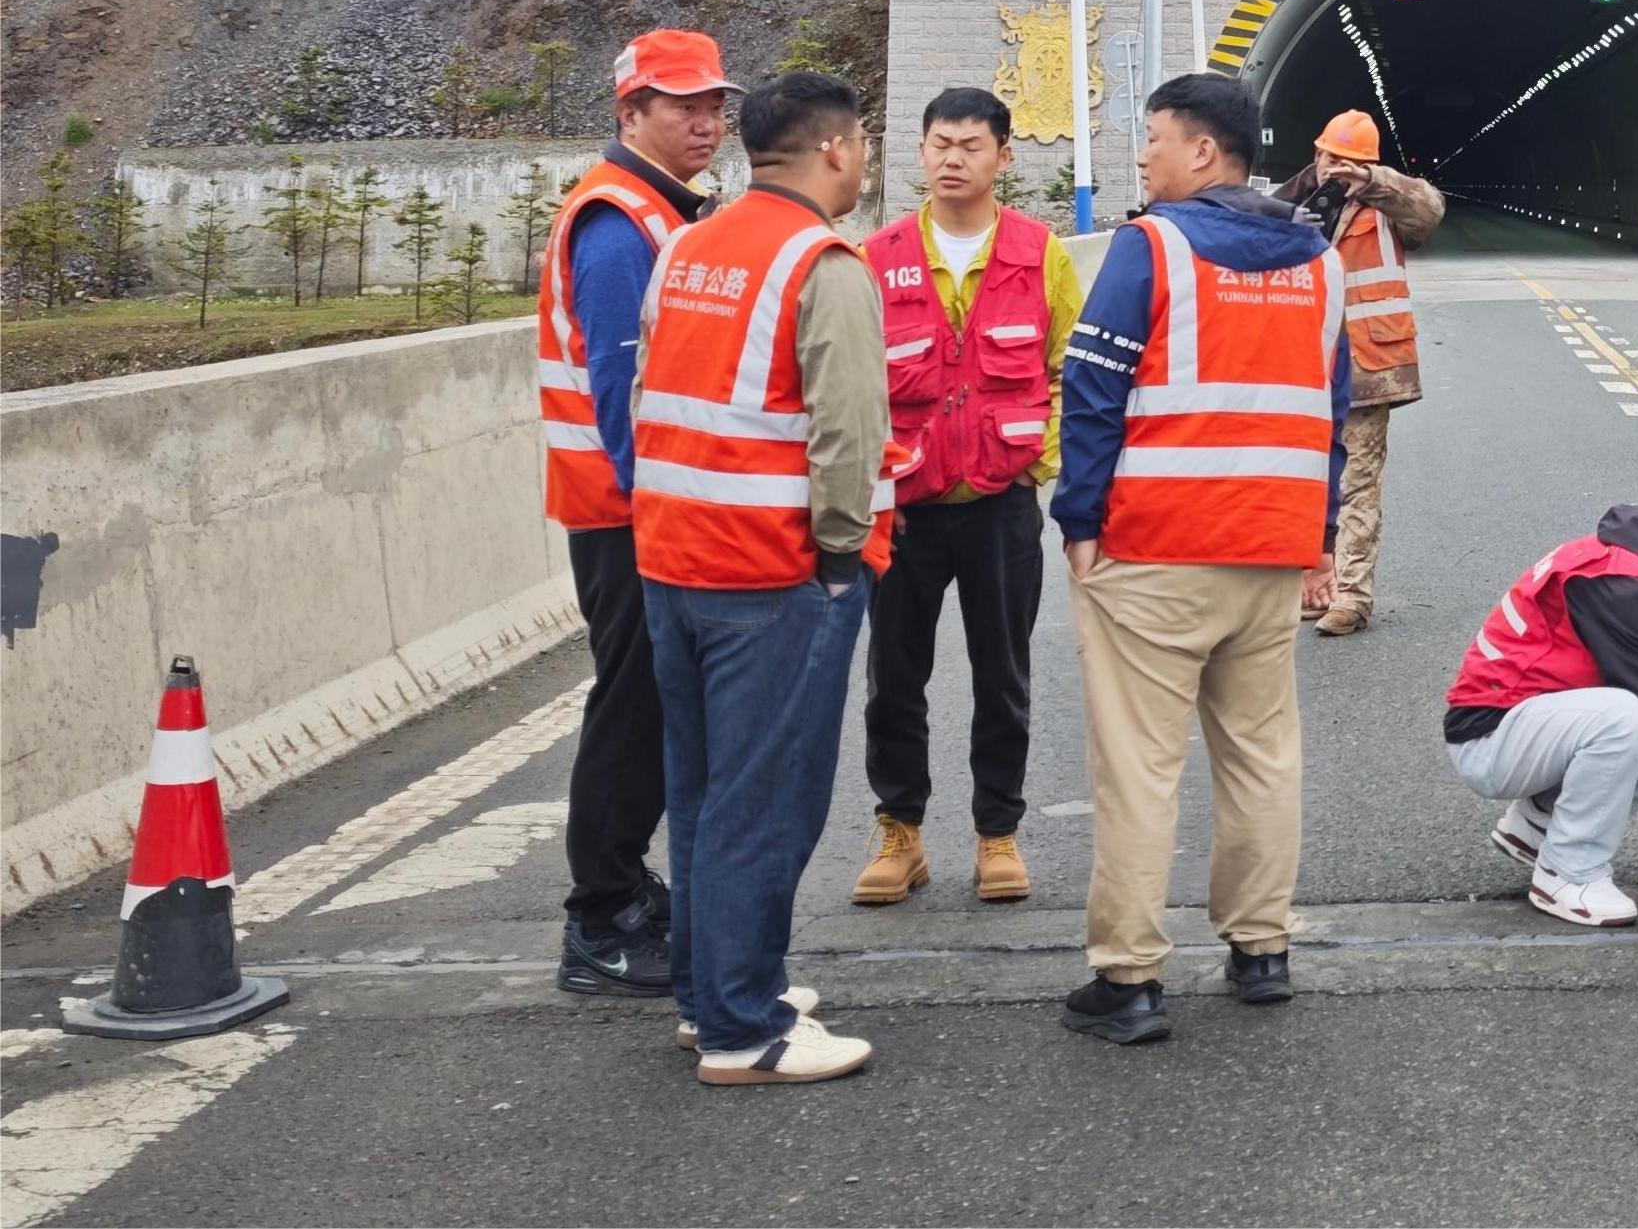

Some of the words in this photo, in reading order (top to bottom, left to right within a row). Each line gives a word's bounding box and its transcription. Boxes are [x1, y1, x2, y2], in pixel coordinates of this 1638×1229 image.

[665, 261, 749, 300] 云南公路
[884, 266, 922, 289] 103
[663, 295, 696, 312] UNNAN
[1216, 291, 1263, 304] YUNNAN
[1266, 292, 1316, 307] HIGHWAY
